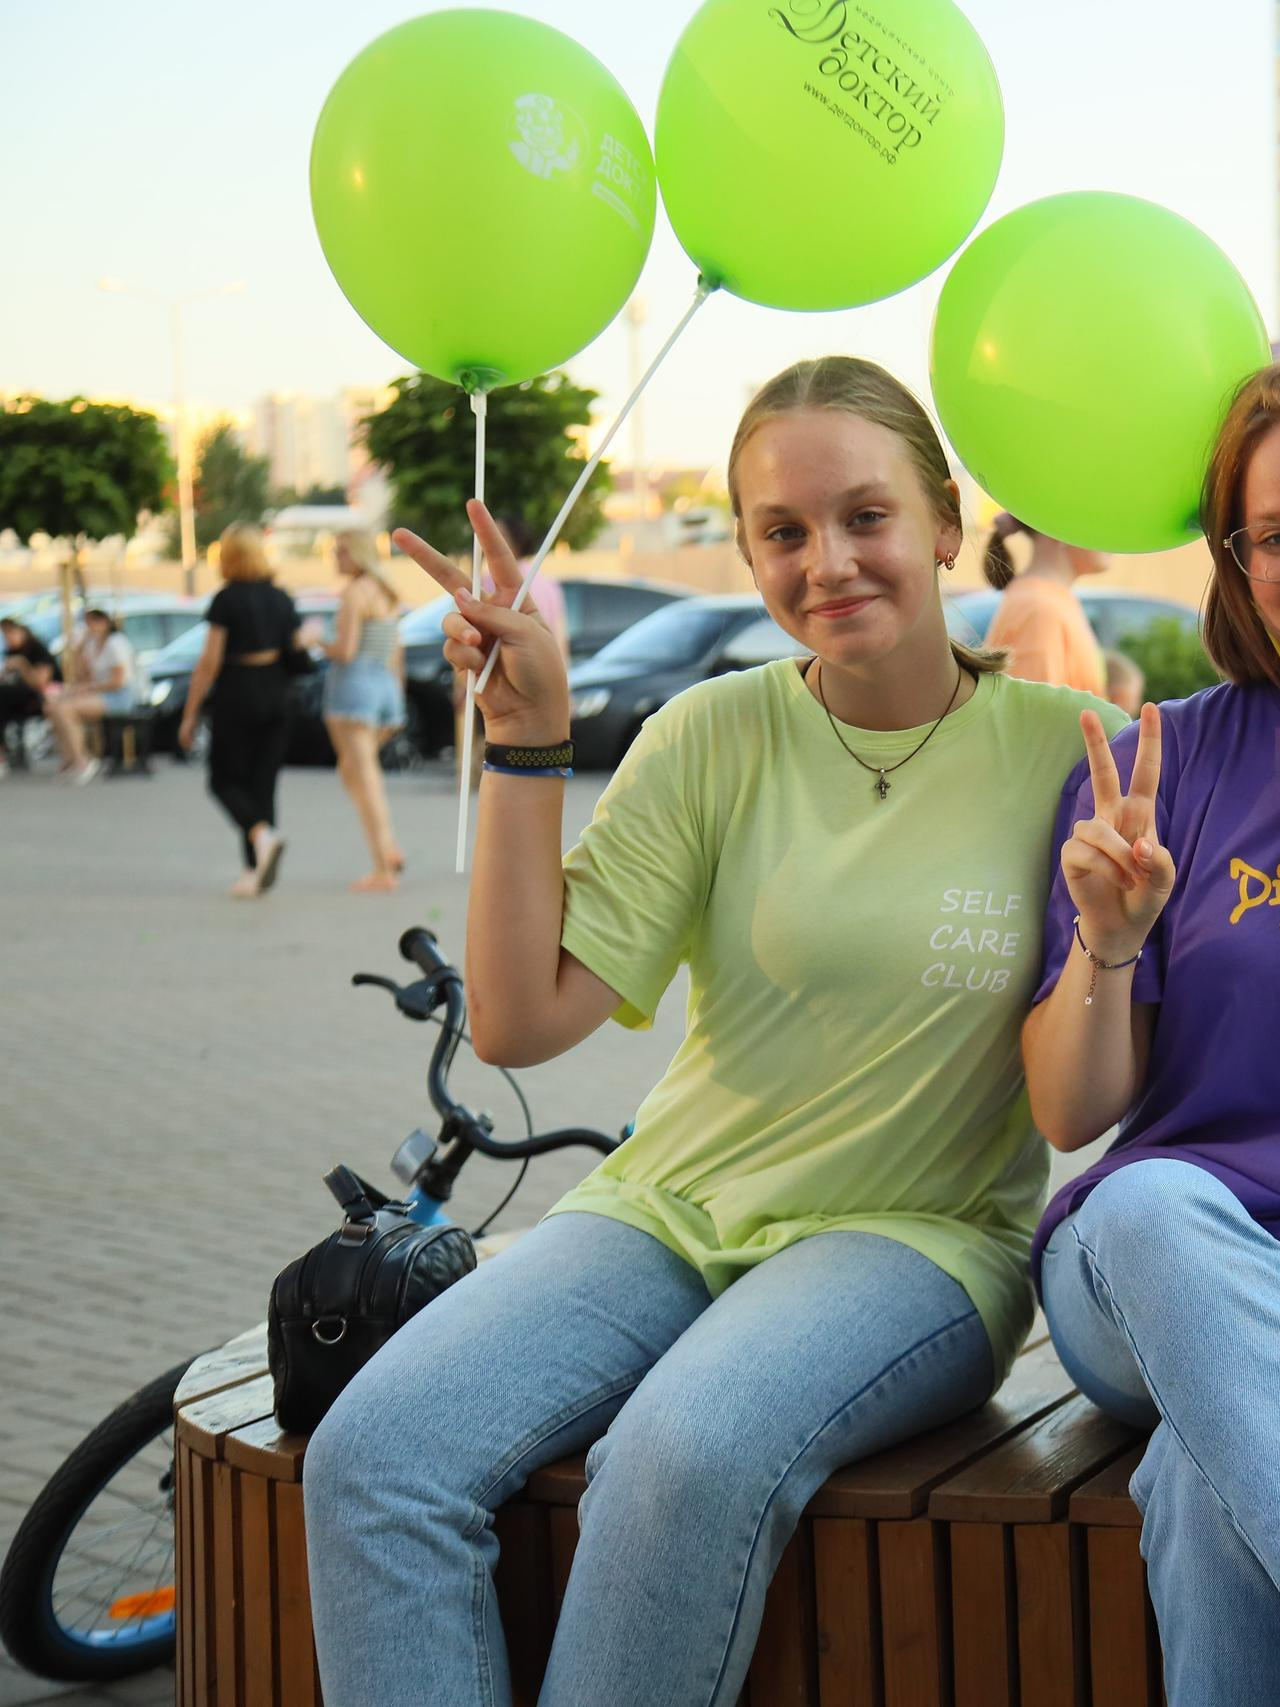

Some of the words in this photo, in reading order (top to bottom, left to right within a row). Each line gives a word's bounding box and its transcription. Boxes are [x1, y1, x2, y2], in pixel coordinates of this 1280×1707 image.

[819, 47, 922, 153] доктор
[803, 81, 897, 165] www.детдоктор.рф
[940, 888, 1022, 918] SELF
[929, 924, 1022, 957] CARE
[921, 962, 1011, 993] CLUB
